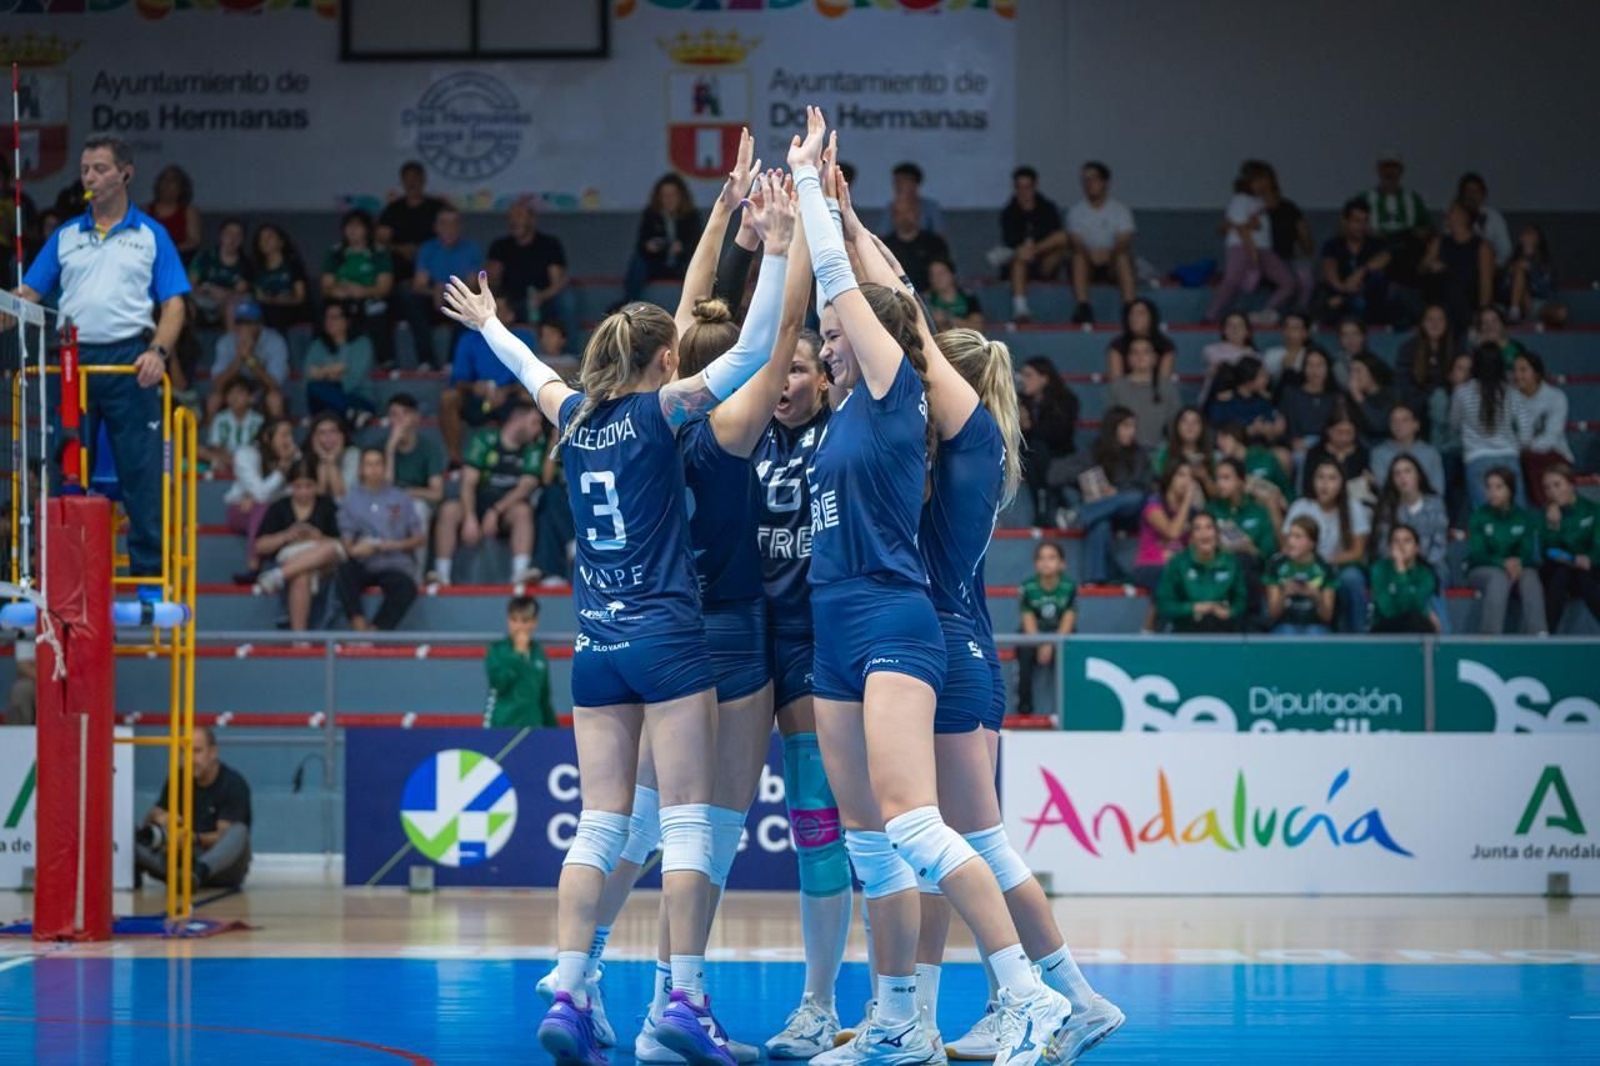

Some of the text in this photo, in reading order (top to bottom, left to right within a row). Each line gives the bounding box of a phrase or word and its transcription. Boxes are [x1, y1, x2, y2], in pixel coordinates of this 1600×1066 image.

[91, 70, 309, 99] Ayuntamiento de
[769, 68, 988, 98] Ayuntamiento de
[92, 104, 309, 130] Dos Hermanas
[769, 103, 989, 129] Do Hermanas
[580, 470, 626, 551] 3
[1249, 686, 1402, 719] Diputación
[1020, 766, 1416, 858] Andalucía
[12, 837, 31, 852] de
[1471, 844, 1519, 859] Junta
[1523, 844, 1543, 859] de
